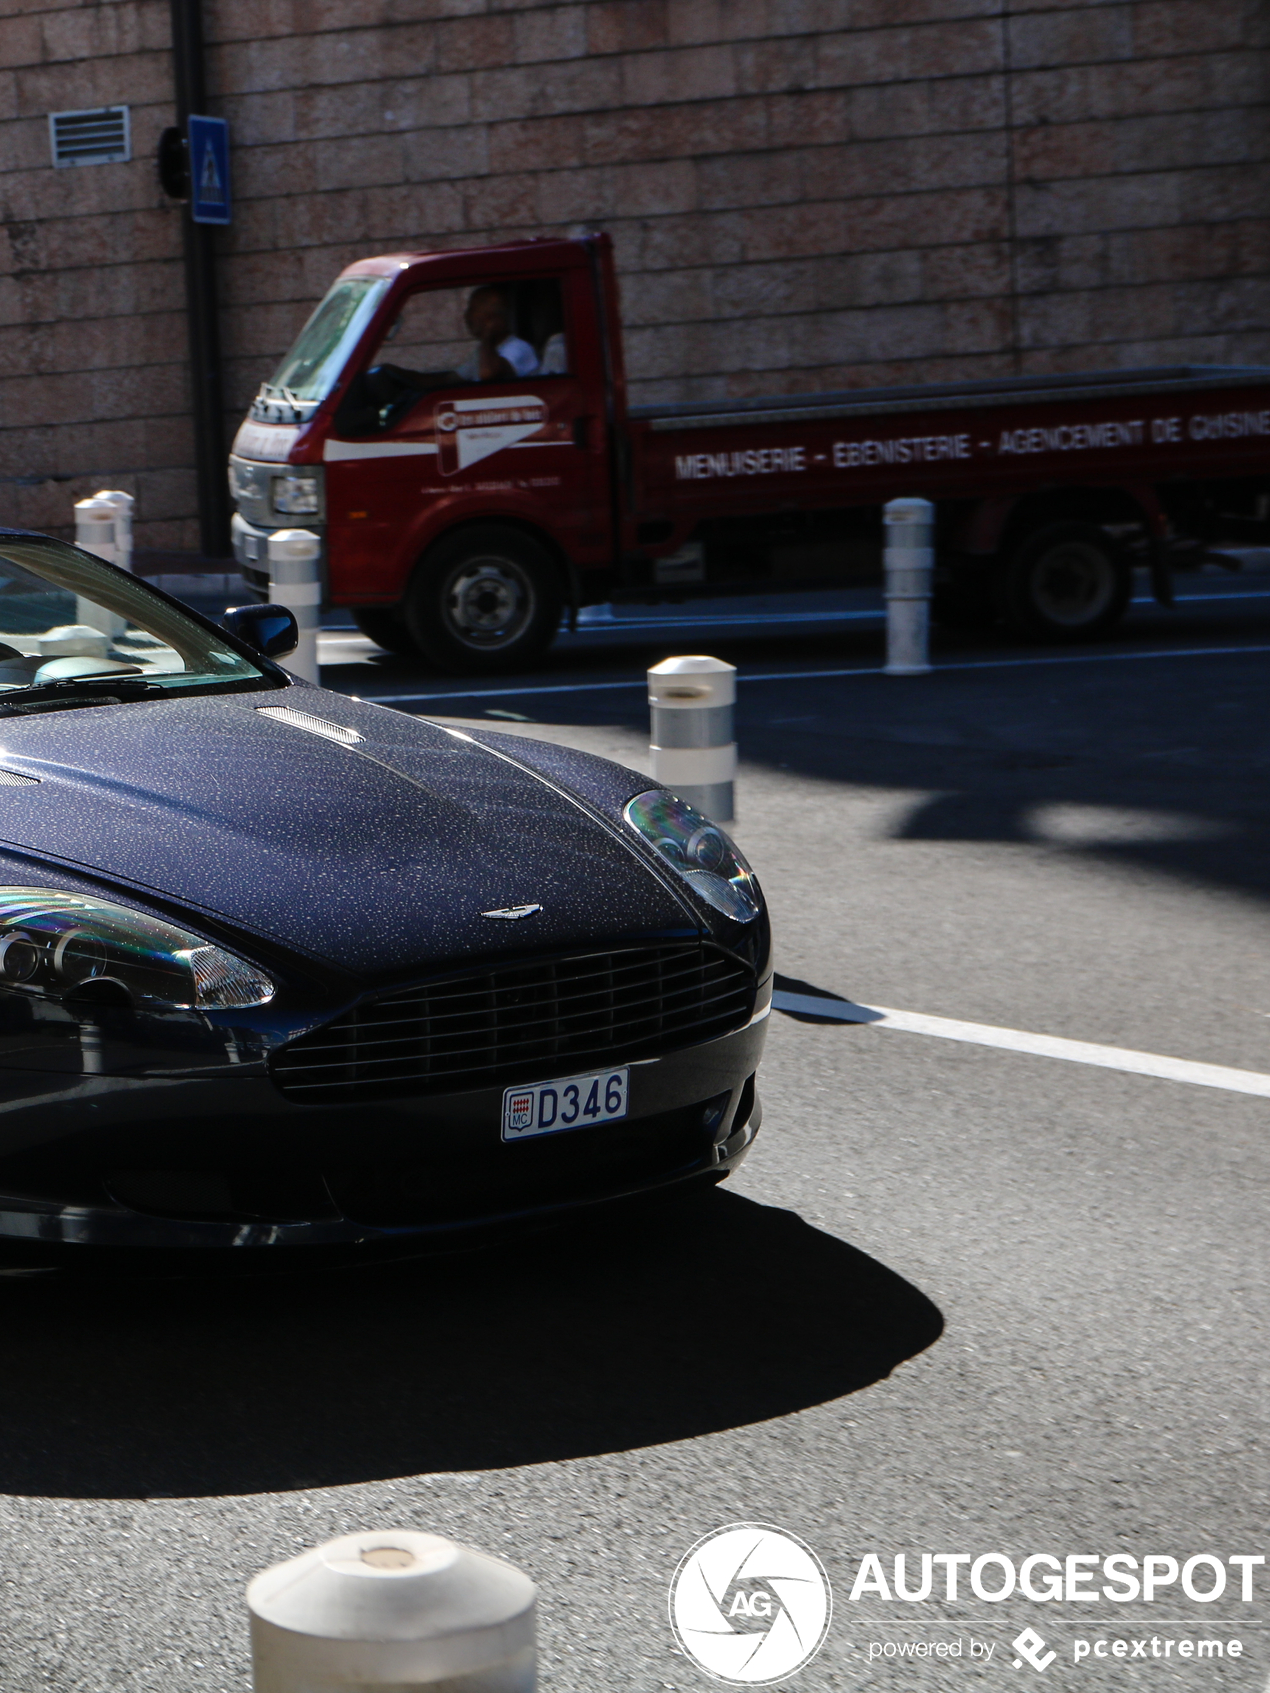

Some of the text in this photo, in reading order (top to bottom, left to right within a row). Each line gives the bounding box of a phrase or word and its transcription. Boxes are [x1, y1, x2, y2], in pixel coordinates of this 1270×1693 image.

[675, 446, 808, 480] MENUISERIE
[998, 420, 1146, 455] AGENCEMENT
[1152, 416, 1183, 443] DE
[512, 1113, 528, 1126] MC
[537, 1074, 623, 1129] D346
